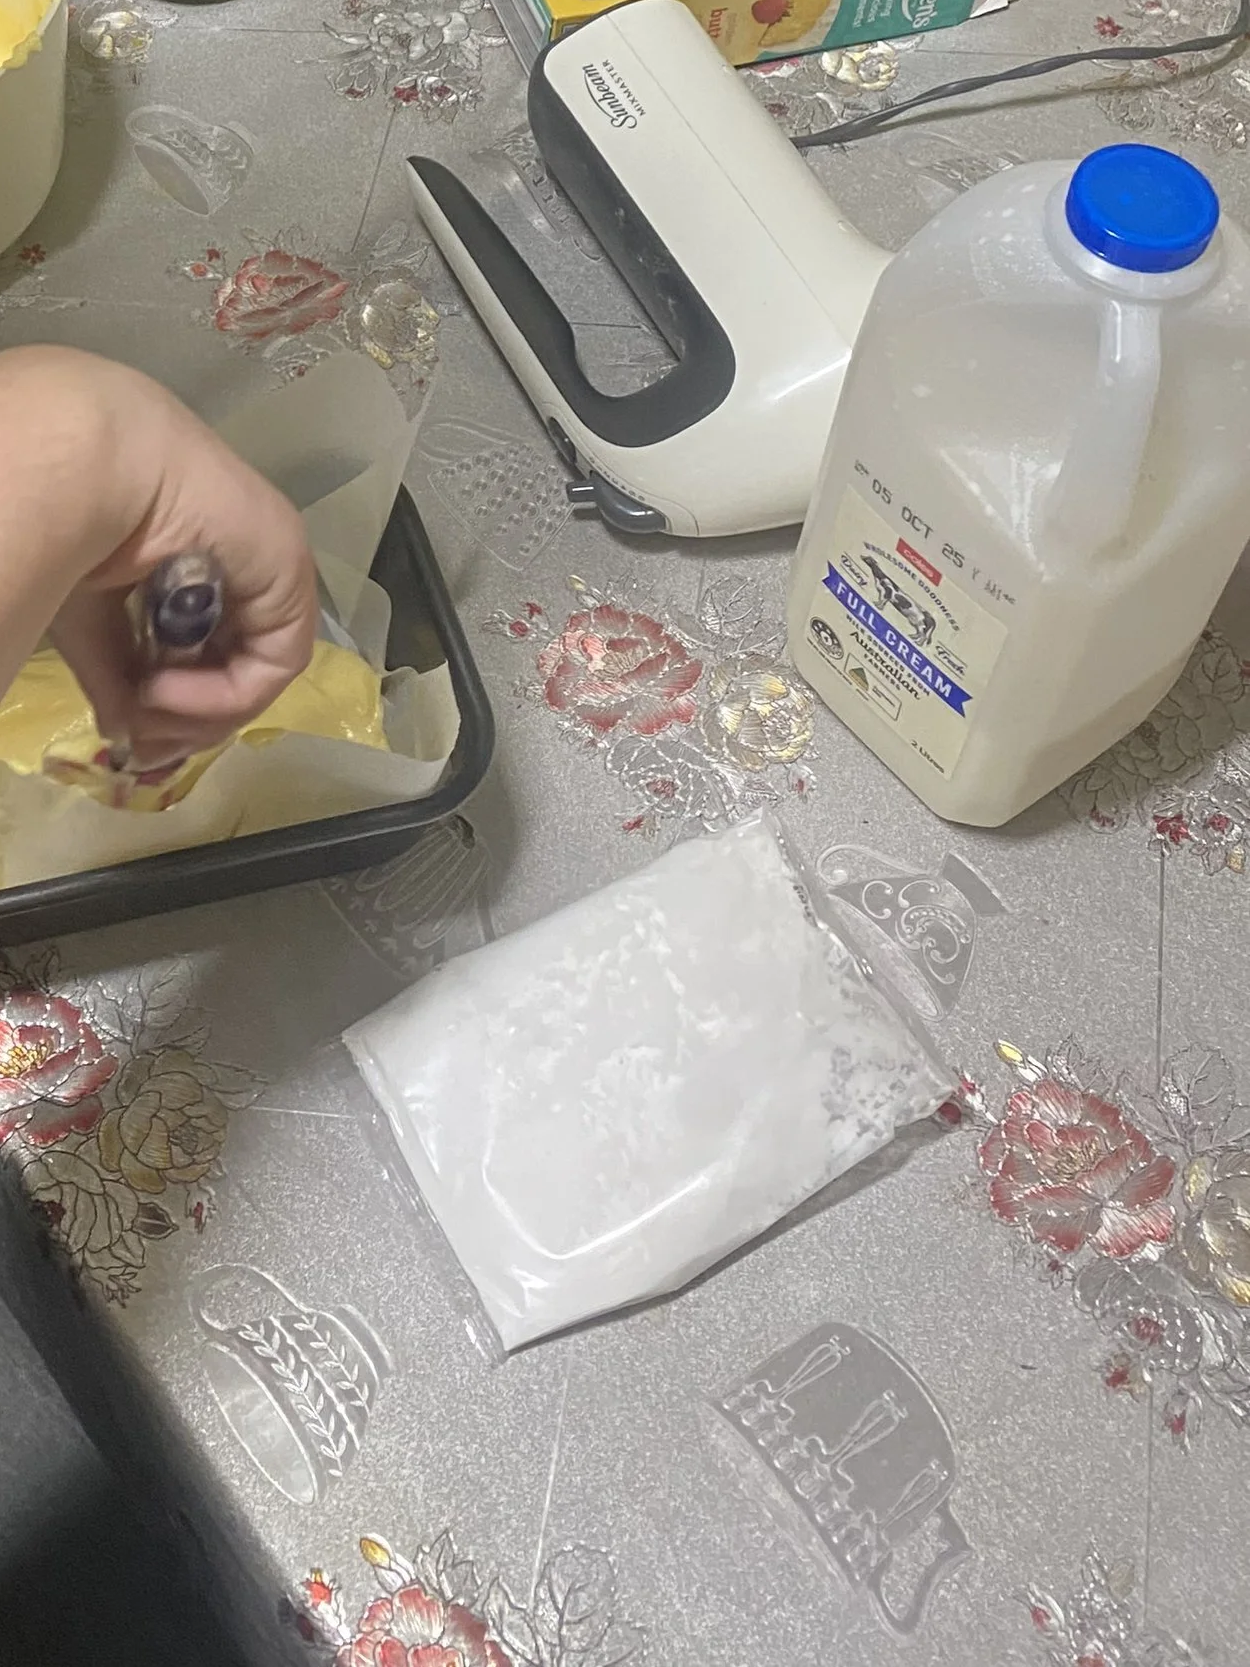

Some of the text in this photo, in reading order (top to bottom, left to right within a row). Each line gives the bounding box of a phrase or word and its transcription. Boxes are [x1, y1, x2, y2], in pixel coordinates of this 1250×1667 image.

[582, 63, 637, 129] Sunbeam
[602, 59, 646, 116] MIXMASTER
[872, 478, 893, 504] 05
[901, 506, 934, 539] OCT
[941, 542, 965, 568] 25
[840, 554, 868, 587] Dairy
[863, 541, 917, 580] WHOLESOME
[918, 579, 962, 632] GOODNESS
[836, 582, 876, 631] FULL
[885, 630, 953, 698] CREAM
[850, 631, 921, 700] Australian
[935, 645, 966, 676] Fresh
[863, 654, 901, 691] FARMERS
[919, 747, 945, 774] Litres
